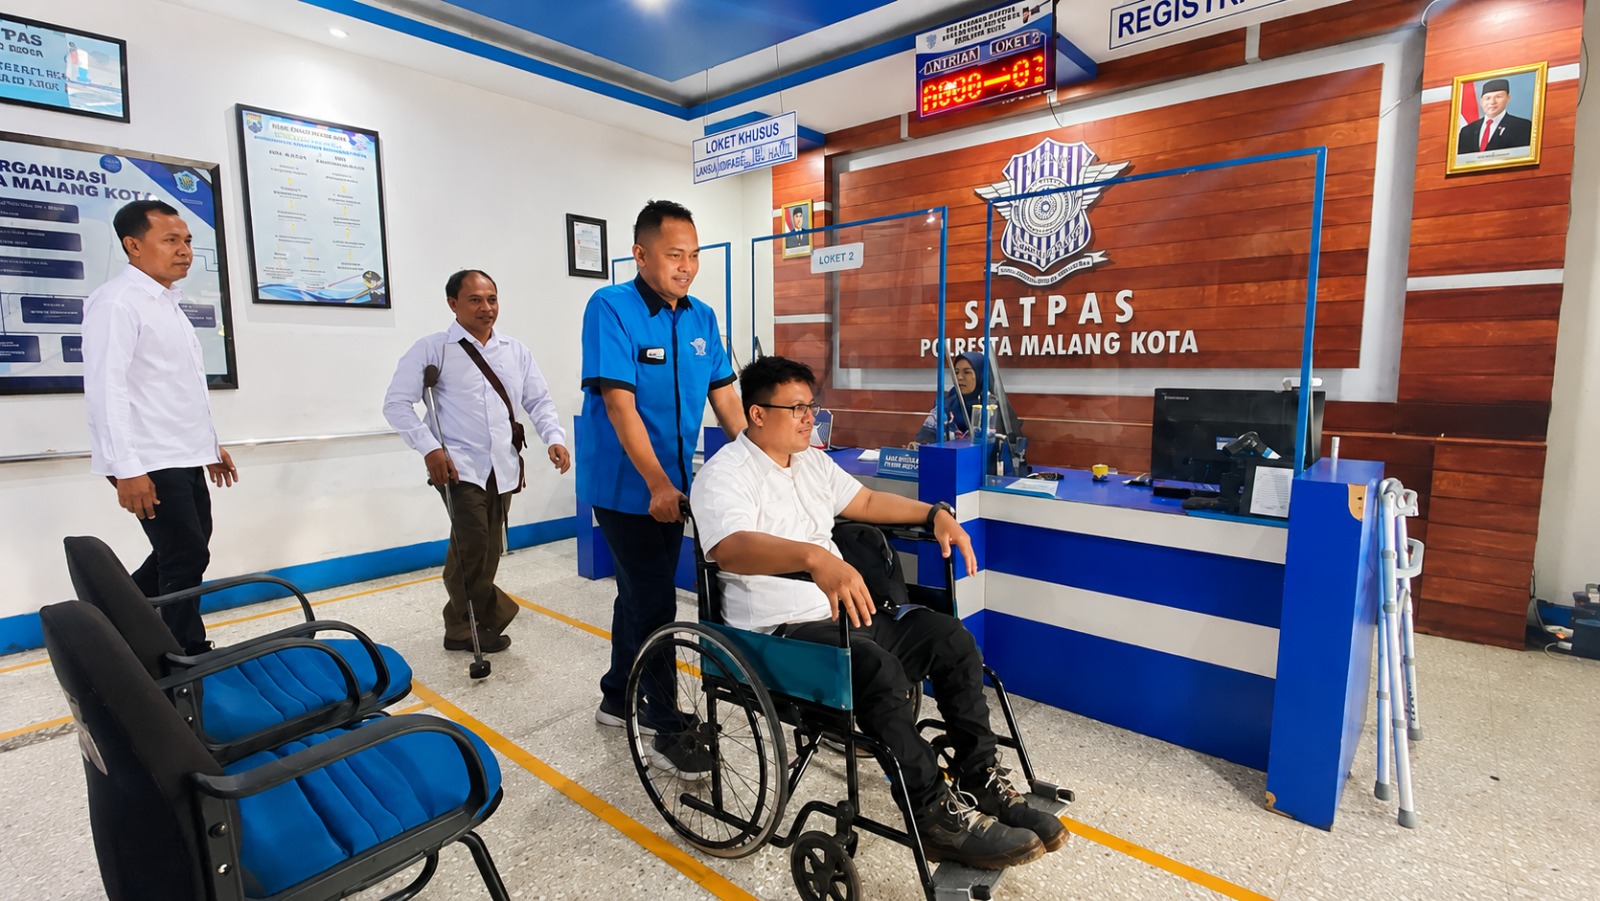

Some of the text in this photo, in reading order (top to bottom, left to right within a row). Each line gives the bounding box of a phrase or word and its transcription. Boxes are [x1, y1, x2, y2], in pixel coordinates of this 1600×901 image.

[1118, 0, 1244, 38] REGIS
[706, 122, 779, 154] LOKET KHUSUS
[0, 160, 107, 184] RGANISASI
[12, 176, 99, 197] MALANG
[819, 251, 854, 265] LOKET 2
[964, 290, 1134, 330] SATPAS
[920, 330, 1198, 358] POLRESTA MALANG KOTA
